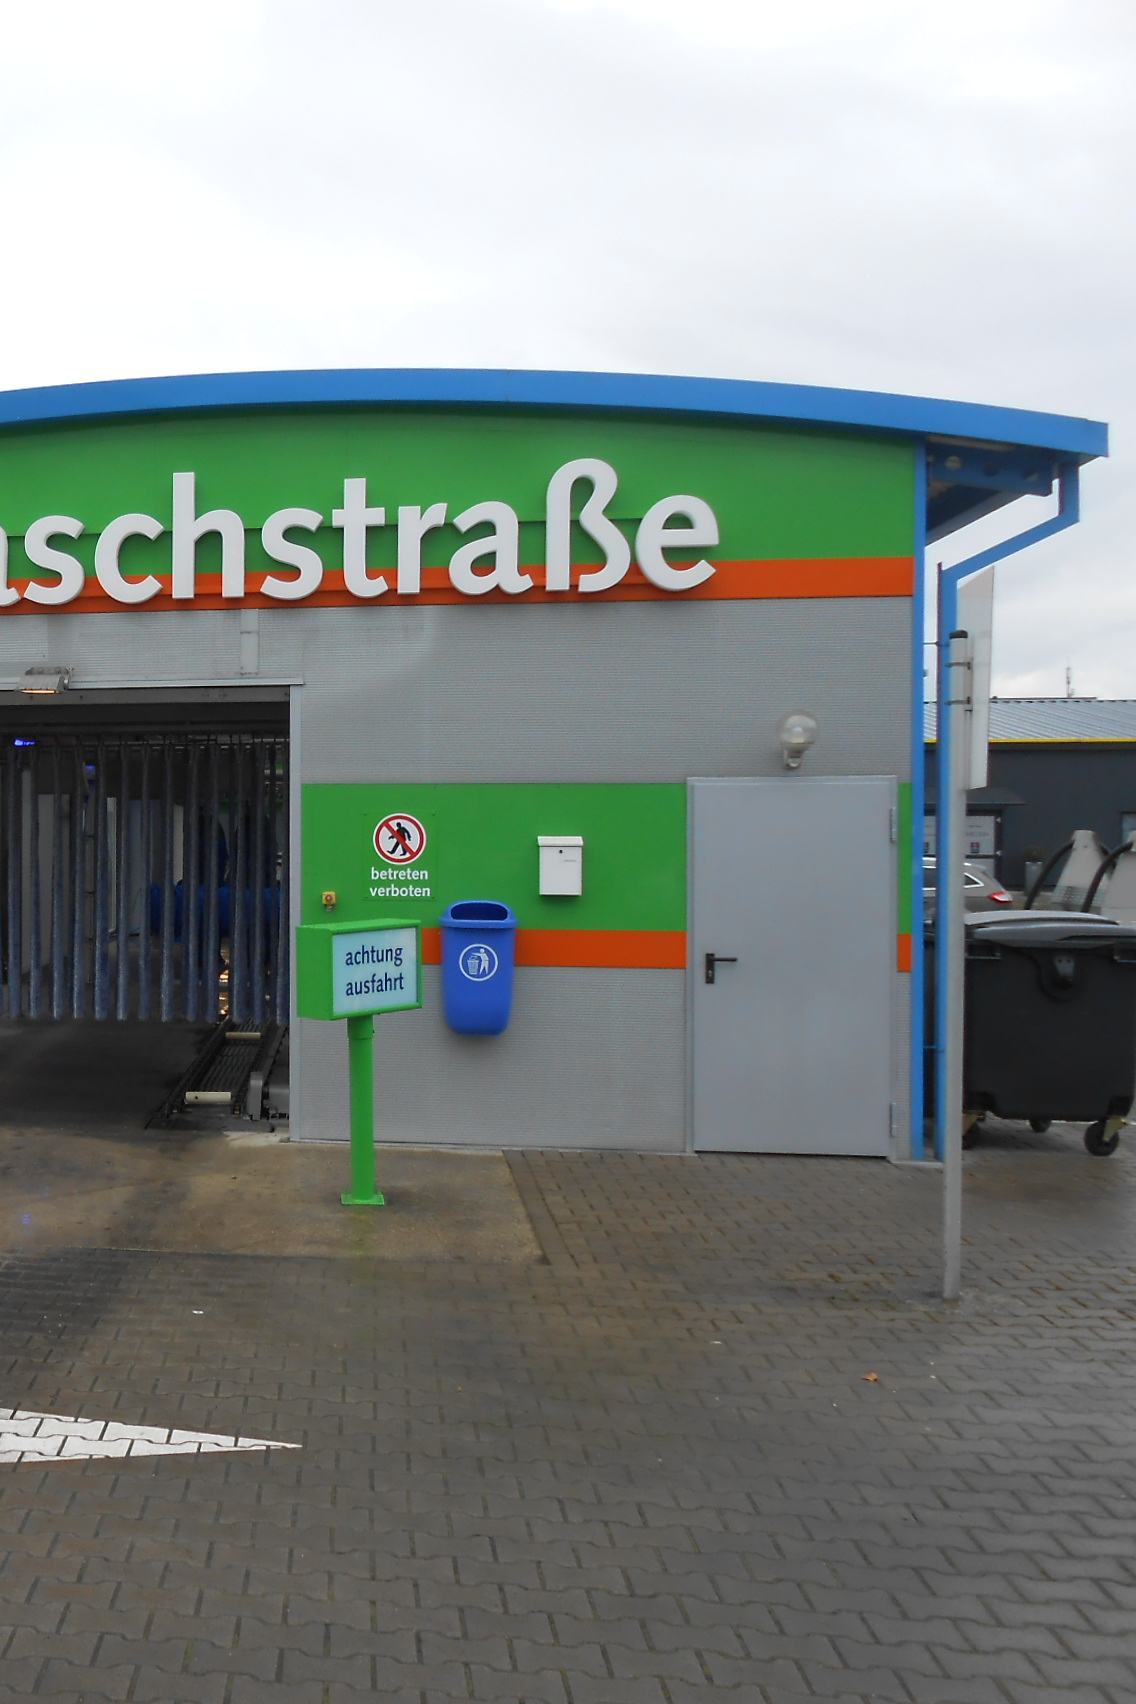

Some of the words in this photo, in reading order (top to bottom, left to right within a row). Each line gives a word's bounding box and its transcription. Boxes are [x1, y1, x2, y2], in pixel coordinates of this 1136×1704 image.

[371, 867, 428, 880] betreten
[369, 884, 431, 898] verboten
[345, 945, 403, 967] achtung
[345, 973, 404, 996] ausfahrt
